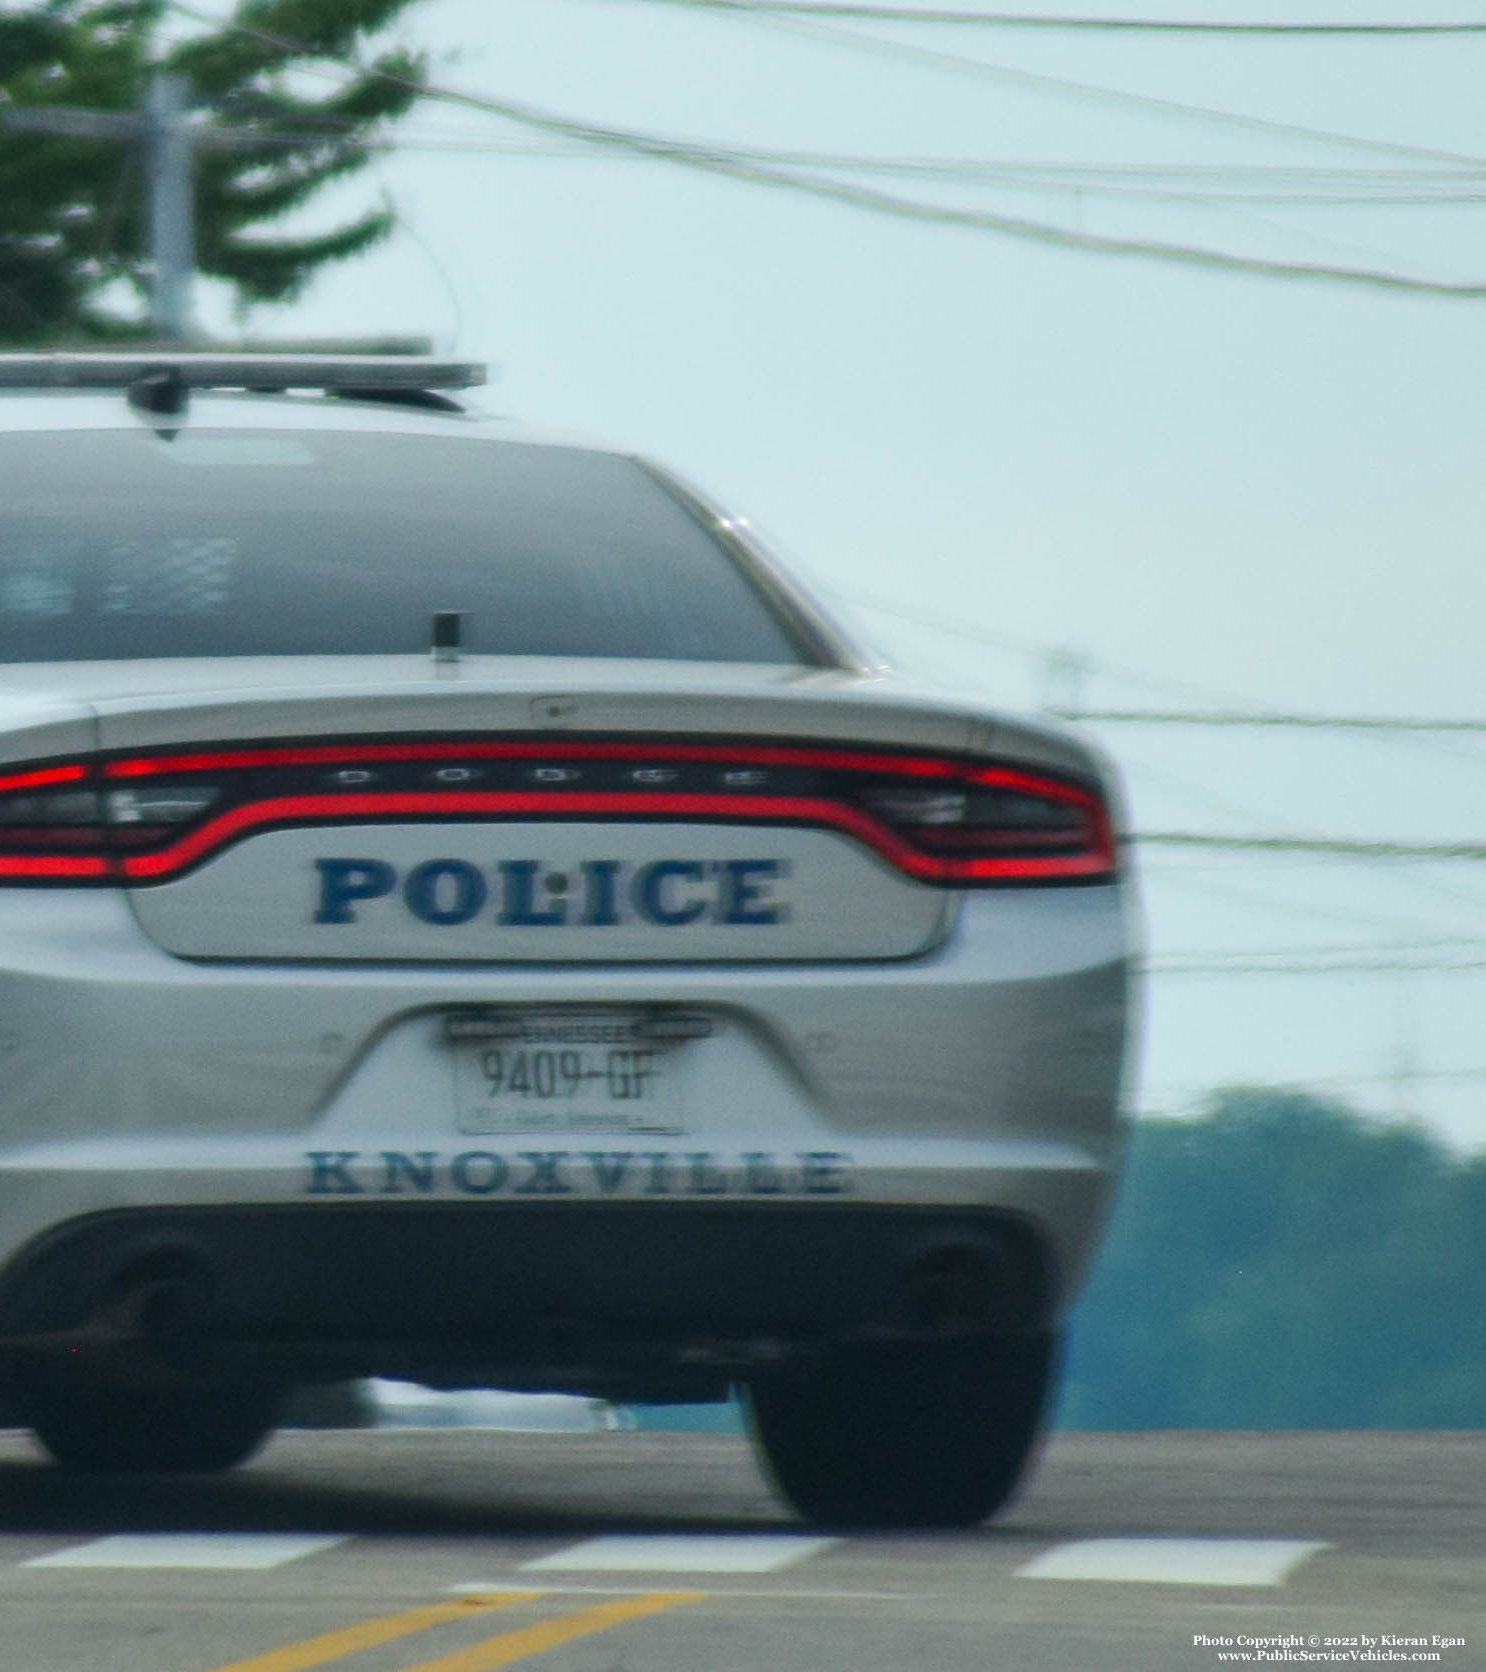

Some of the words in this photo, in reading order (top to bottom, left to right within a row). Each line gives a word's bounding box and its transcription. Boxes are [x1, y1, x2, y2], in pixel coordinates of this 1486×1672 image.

[334, 765, 768, 787] DODGE
[314, 858, 788, 926] POLICE
[305, 1152, 854, 1195] KNOXVILLE
